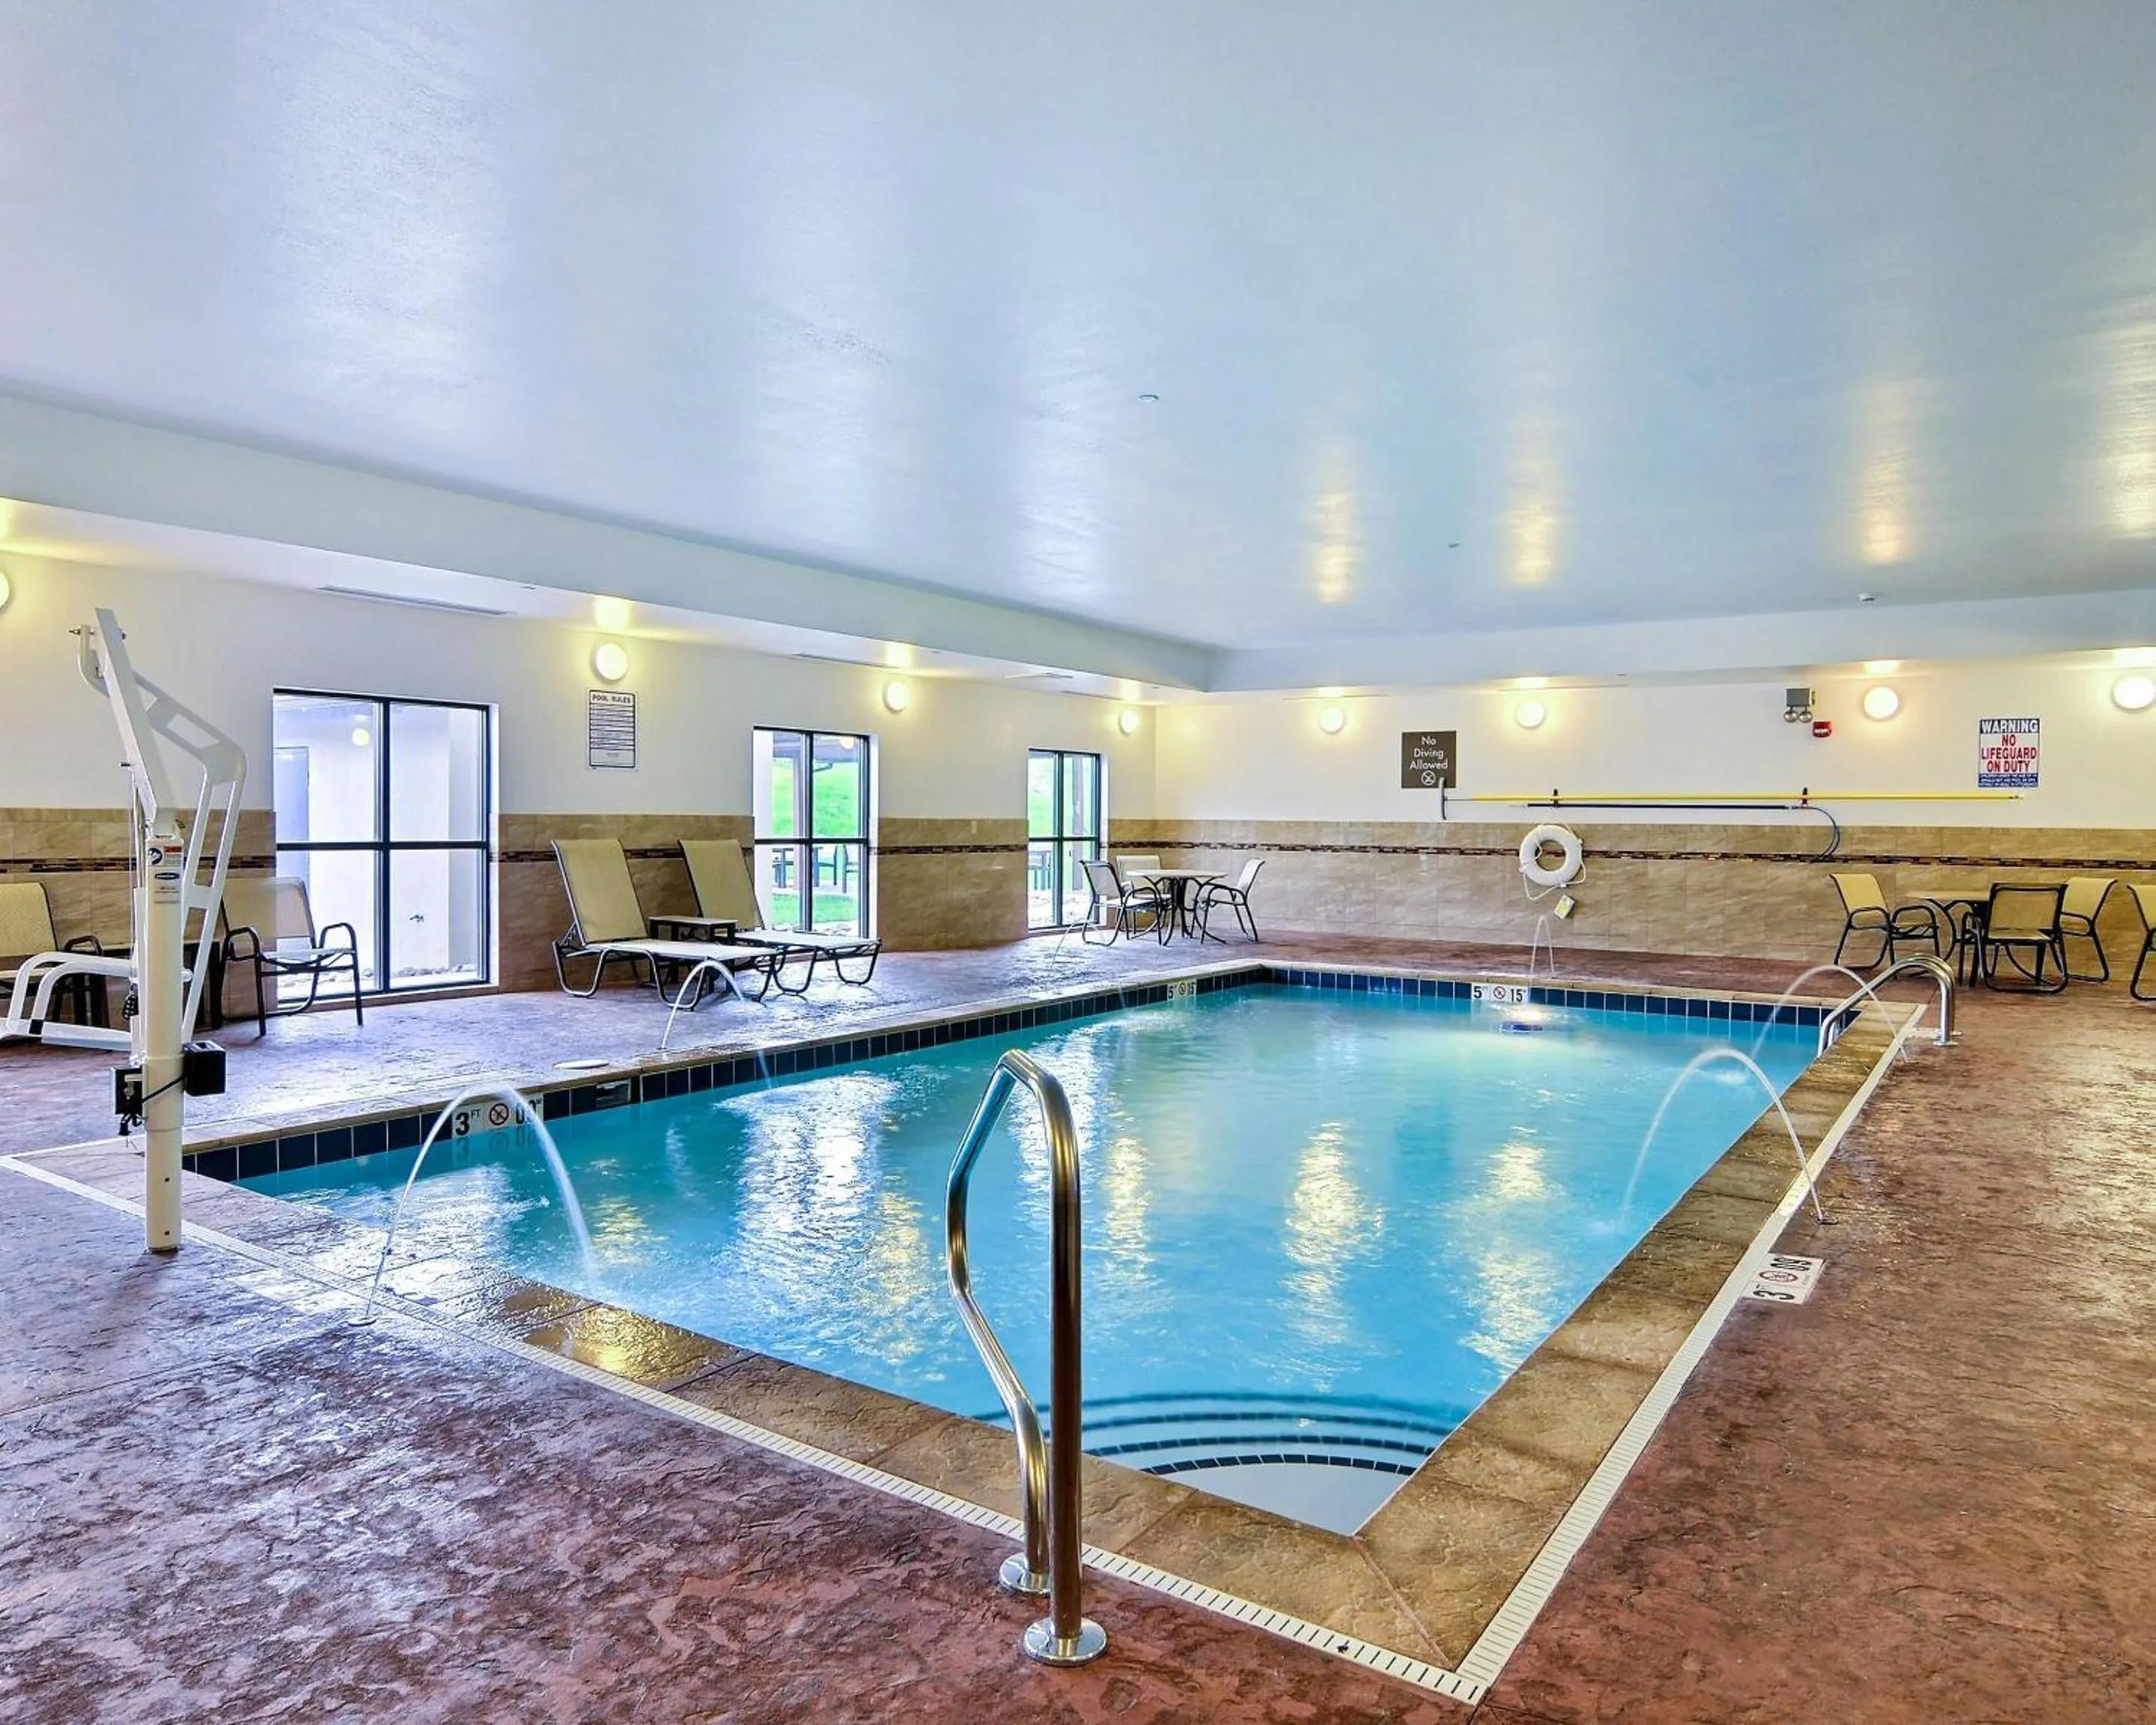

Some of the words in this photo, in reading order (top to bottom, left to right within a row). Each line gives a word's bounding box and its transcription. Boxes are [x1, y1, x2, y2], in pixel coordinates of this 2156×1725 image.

[1981, 719, 2038, 733] WARNING
[1421, 735, 1437, 746] No
[2001, 734, 2016, 746] NO
[1413, 747, 1444, 760] Diving
[1981, 746, 2037, 760] LIFEGUARD
[1409, 758, 1449, 770] Allowed
[1987, 760, 2000, 773] ON
[2003, 760, 2030, 773] DUTY
[1473, 985, 1482, 999] 5
[455, 1112, 470, 1136] 3
[471, 1109, 480, 1119] FT
[1752, 1290, 1795, 1300] 3
